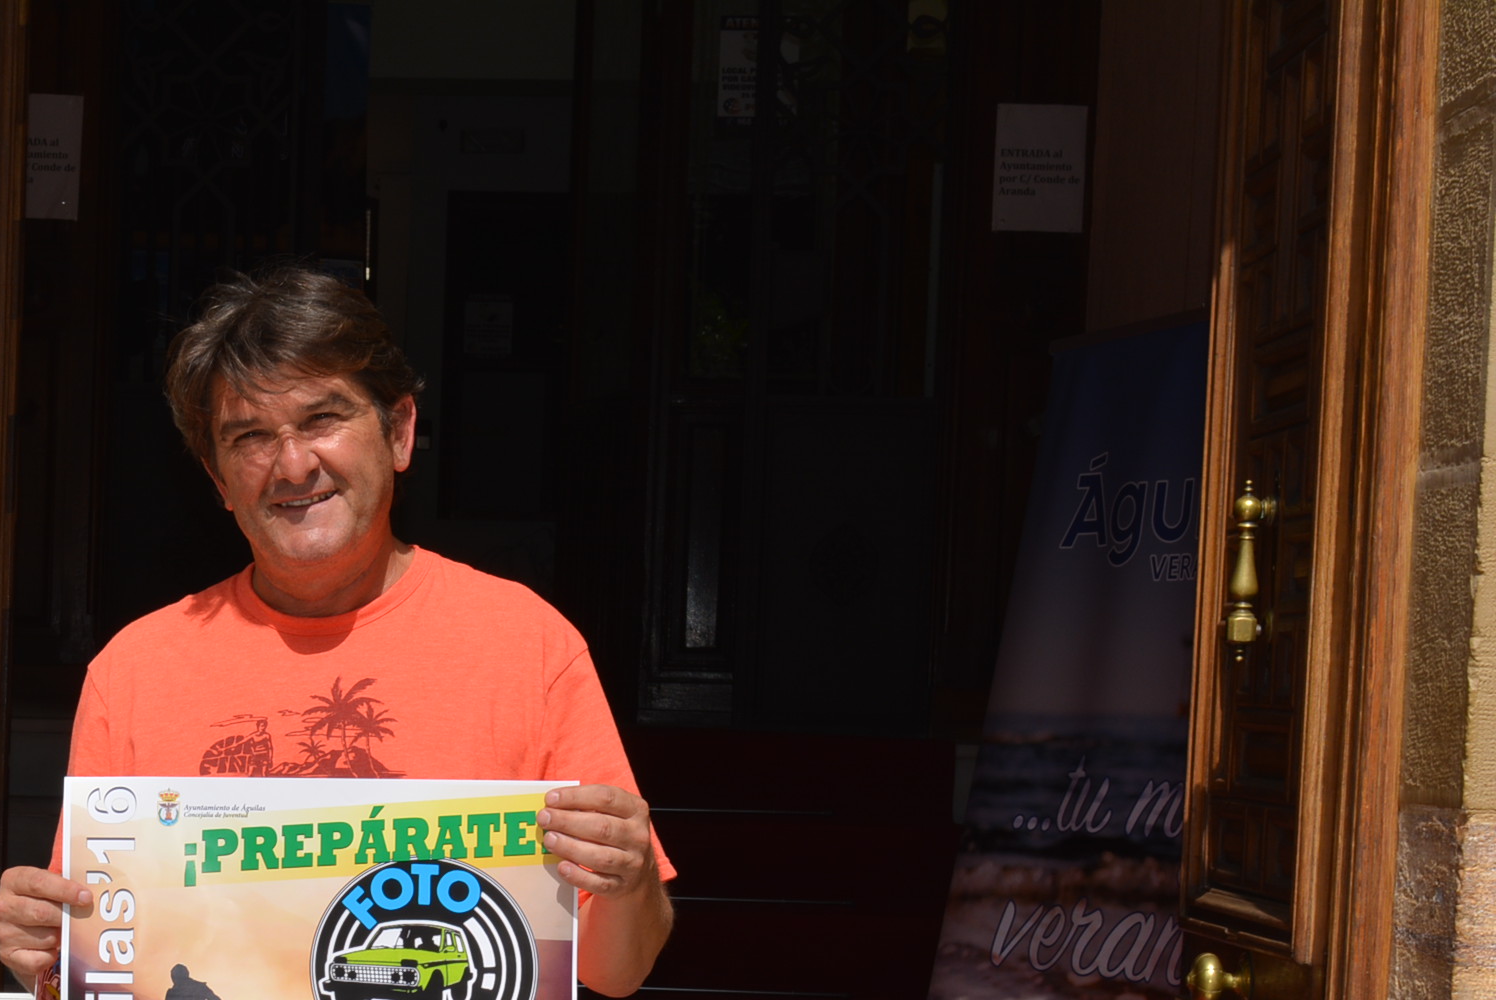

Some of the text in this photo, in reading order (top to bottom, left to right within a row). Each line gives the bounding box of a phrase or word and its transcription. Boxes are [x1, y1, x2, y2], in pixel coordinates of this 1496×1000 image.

[725, 16, 760, 30] ATEN
[49, 138, 59, 147] al
[27, 150, 69, 159] amiento
[1000, 148, 1063, 158] ENTRADA al
[31, 162, 76, 172] Conde de
[999, 160, 1072, 171] Ayuntamiento
[998, 174, 1081, 184] por C/ Conde de
[998, 186, 1036, 196] Aranda
[1059, 451, 1199, 567] Águ
[1149, 552, 1198, 582] VER
[183, 802, 266, 814] Ayuntamiento de Águilas
[1125, 778, 1184, 838] m
[341, 863, 482, 930] FOTO
[991, 898, 1184, 987] veran
